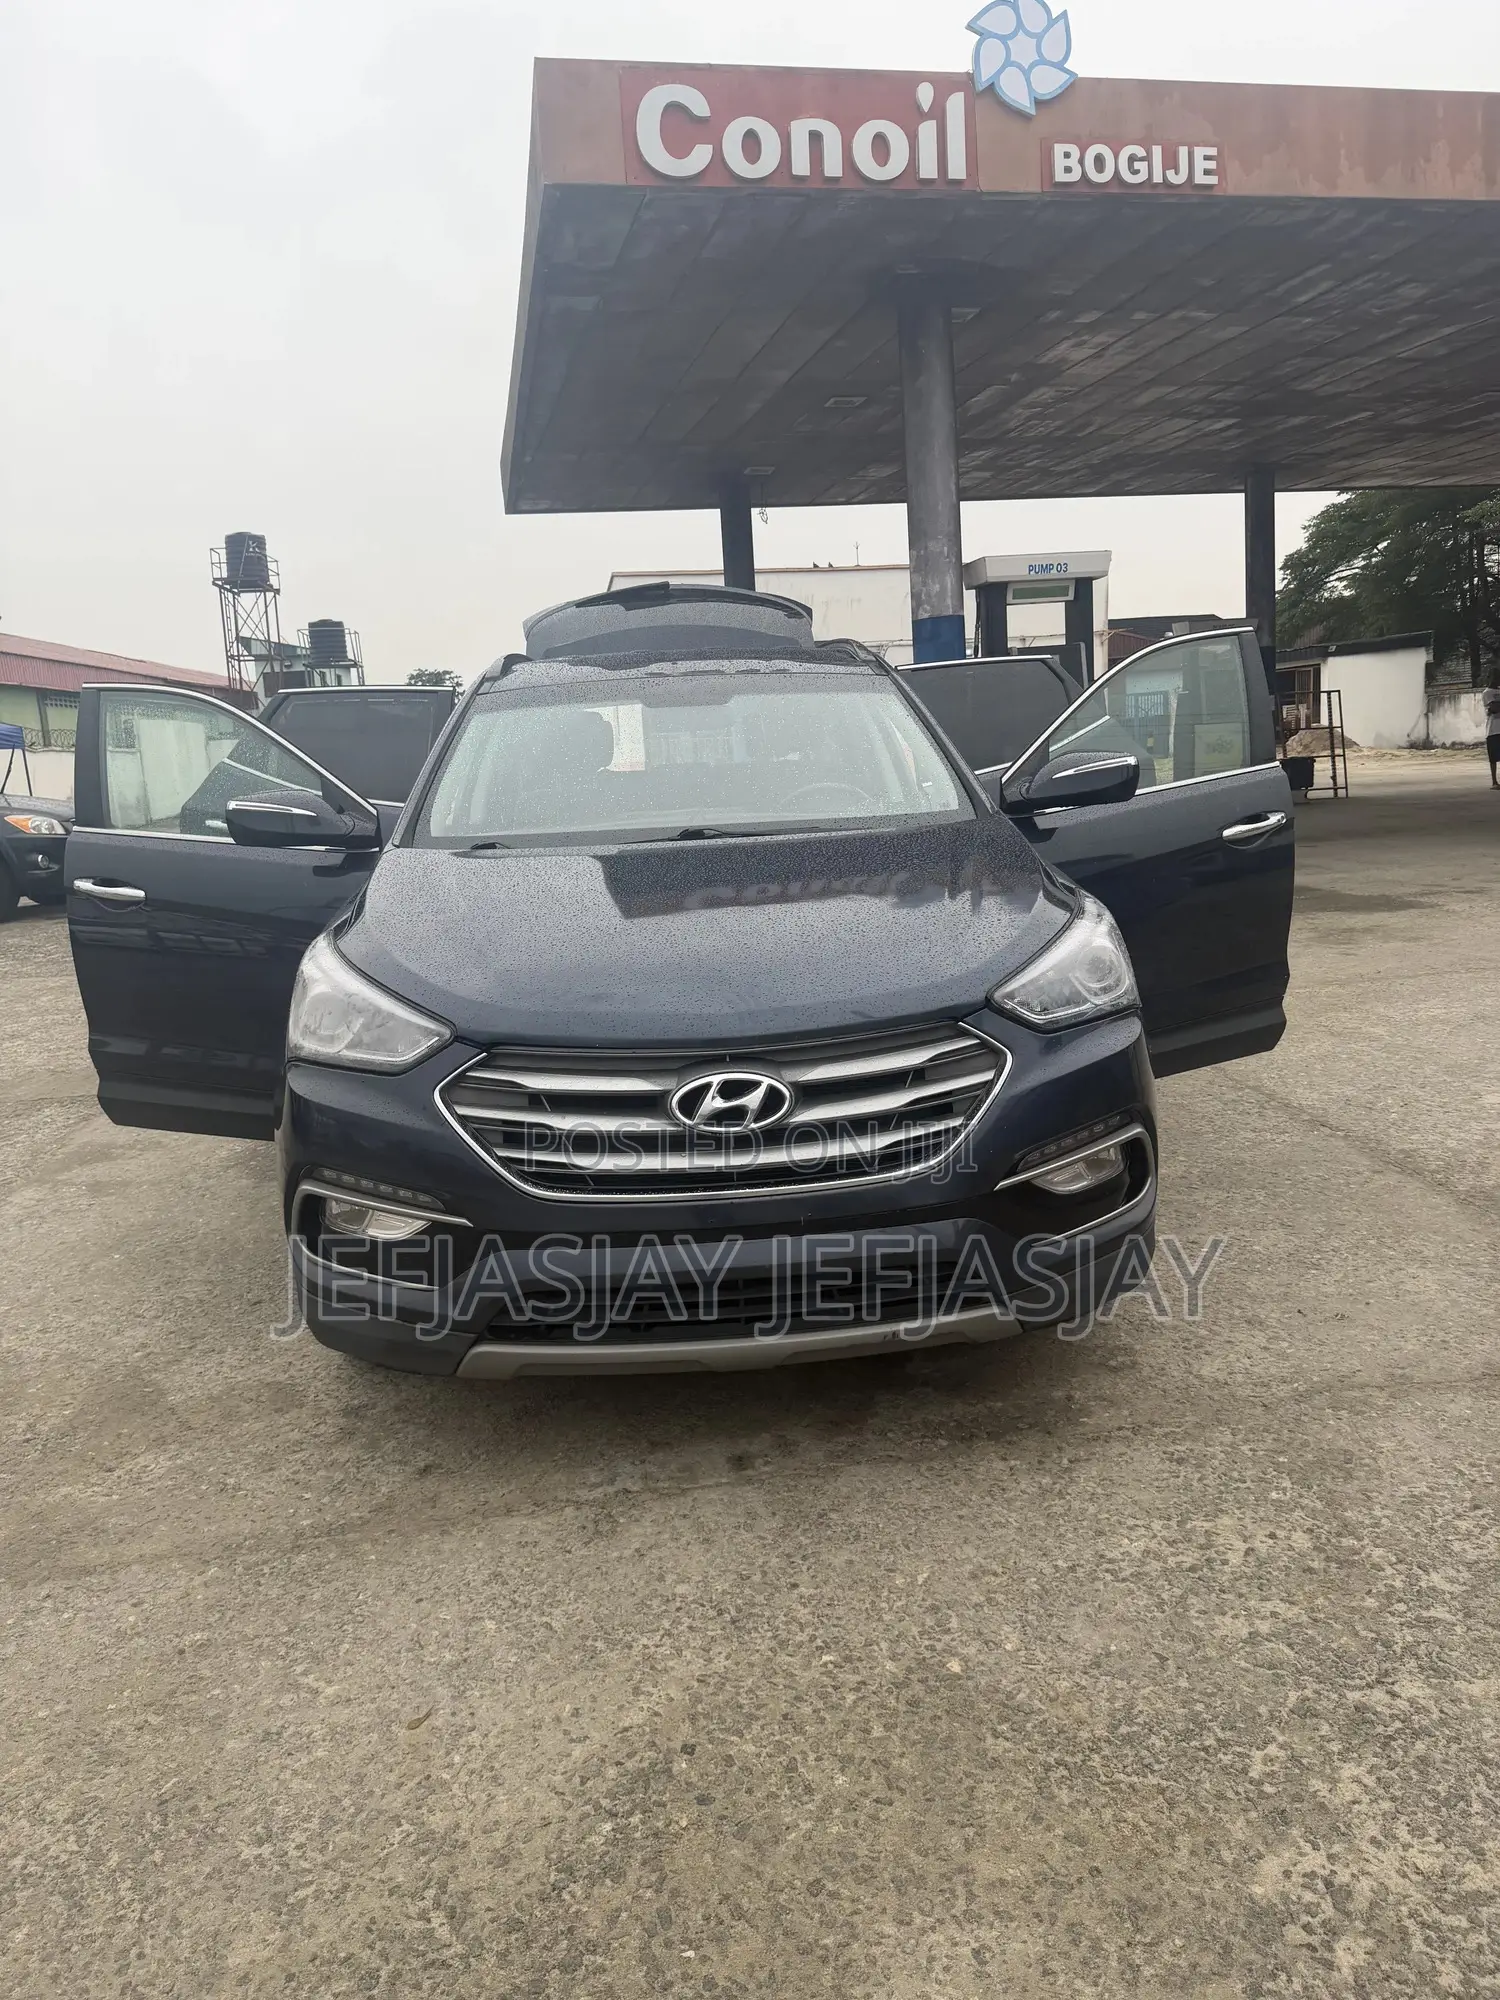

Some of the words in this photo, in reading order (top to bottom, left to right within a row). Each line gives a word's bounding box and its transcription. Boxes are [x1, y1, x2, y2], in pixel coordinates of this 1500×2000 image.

[636, 82, 967, 181] Conoil
[1053, 143, 1219, 186] BOGIJE
[1028, 563, 1055, 575] PUMP
[1056, 562, 1069, 574] 03
